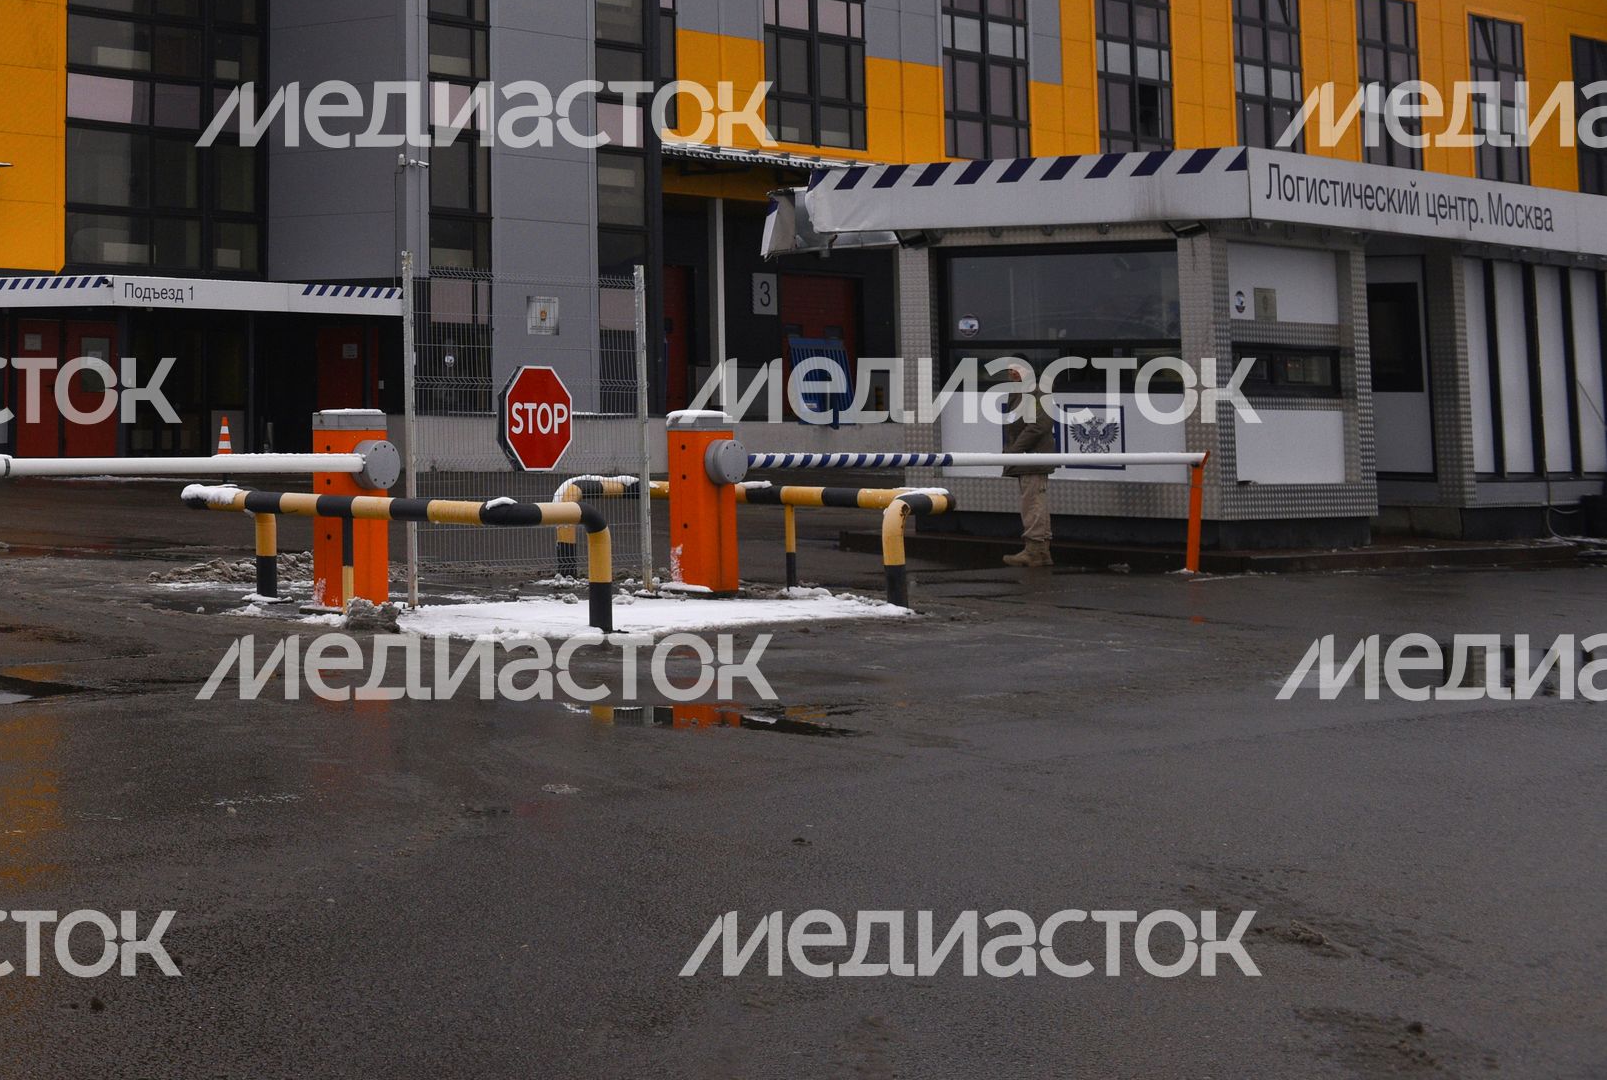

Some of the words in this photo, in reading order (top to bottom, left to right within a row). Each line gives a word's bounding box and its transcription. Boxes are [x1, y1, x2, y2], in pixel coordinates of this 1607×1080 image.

[1265, 163, 1421, 218] Логистический
[1425, 192, 1484, 231] центр.
[1487, 191, 1554, 232] Москва
[124, 283, 184, 303] Подъезд
[188, 285, 194, 301] 1
[760, 281, 771, 307] 3
[511, 402, 569, 435] STOP
